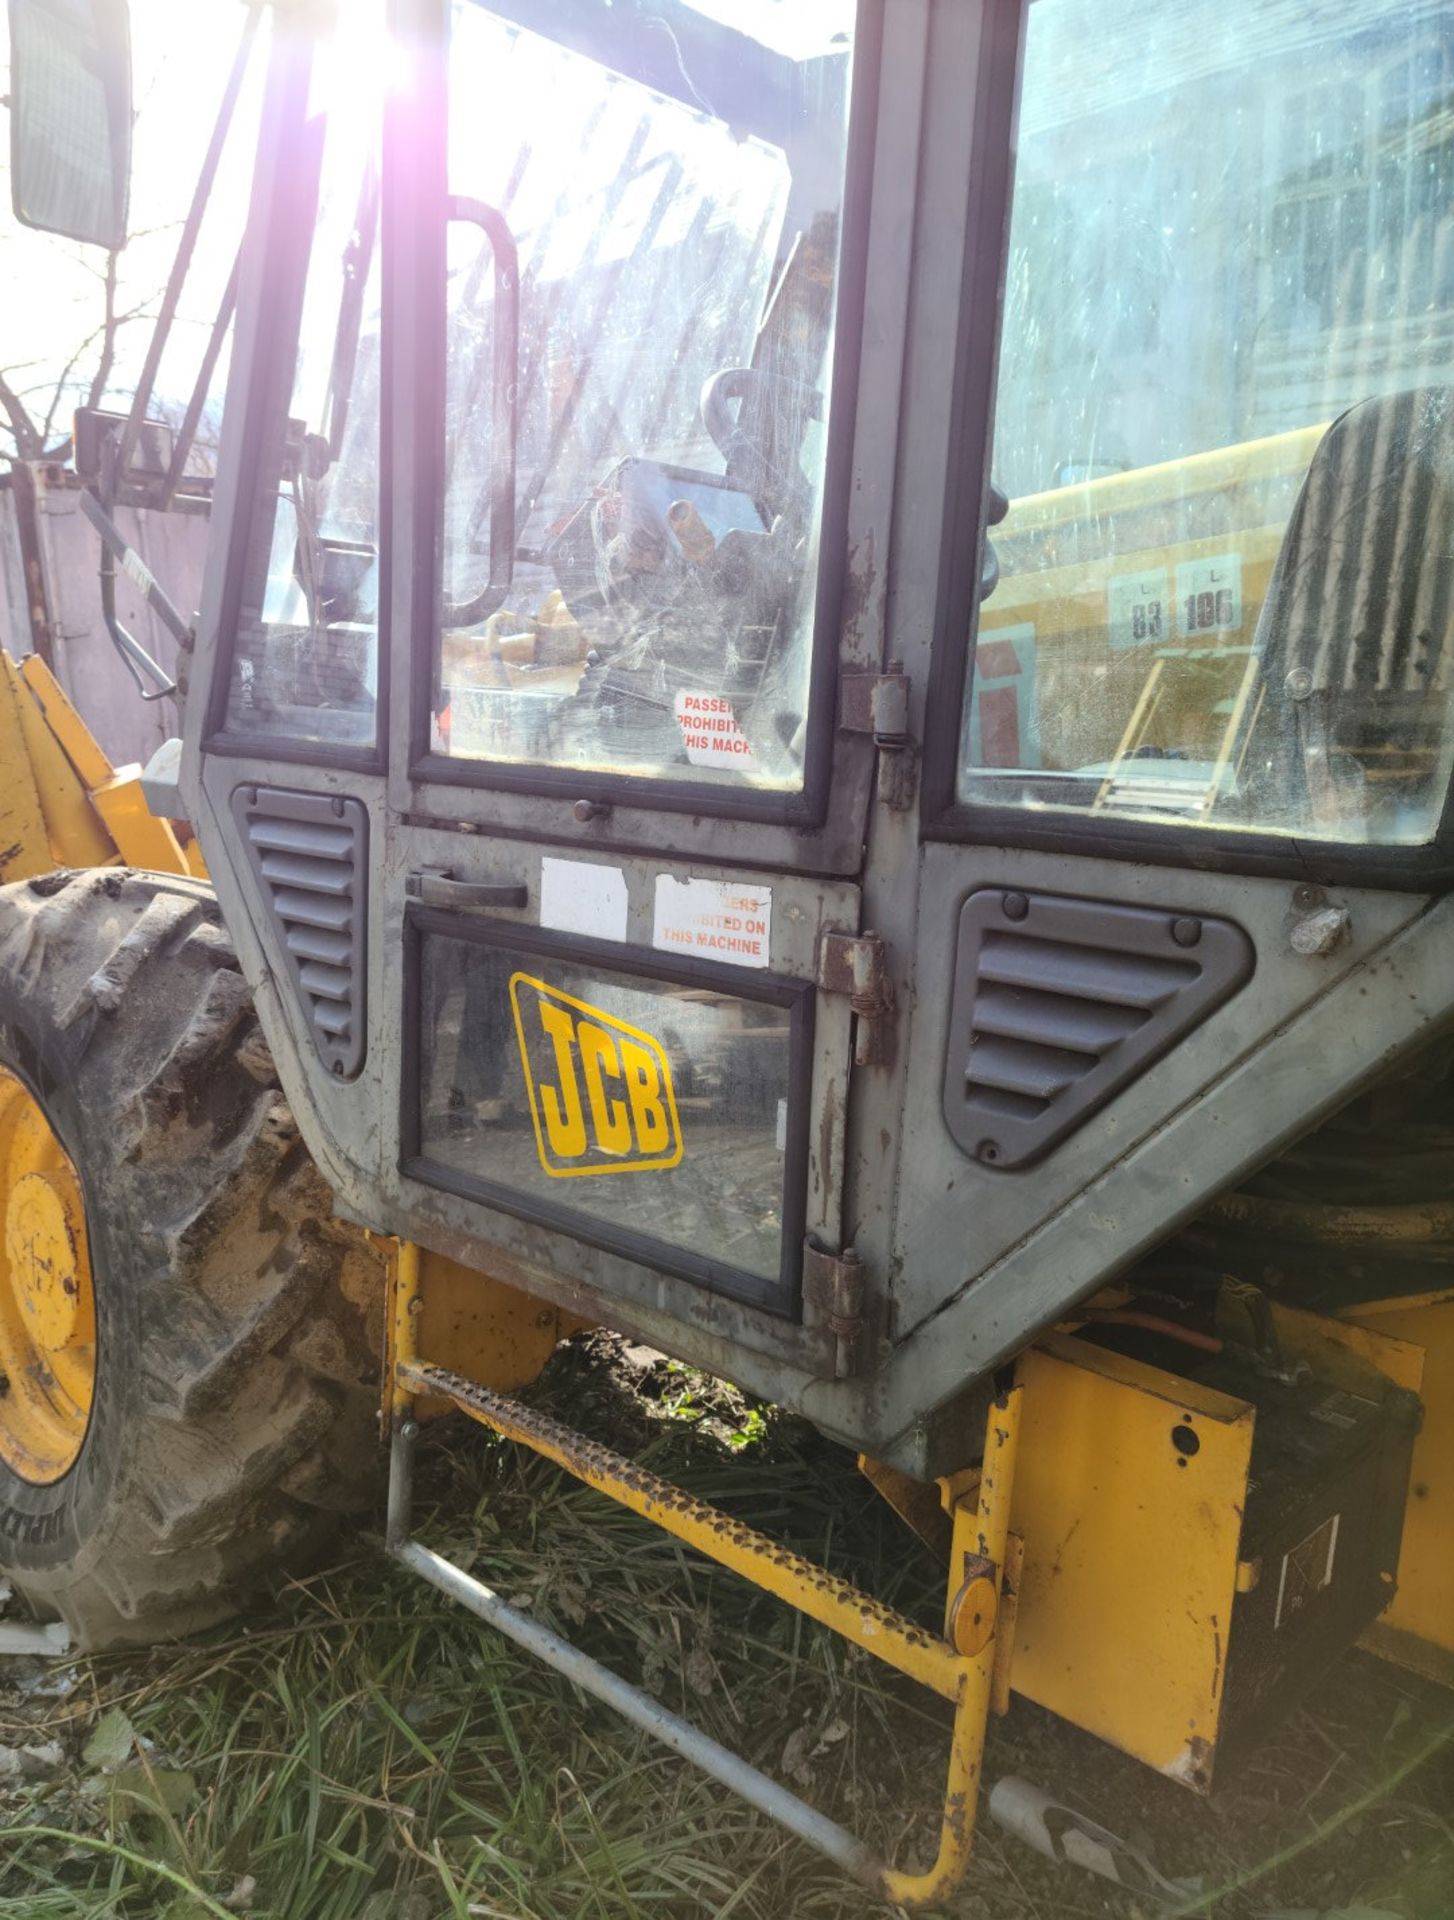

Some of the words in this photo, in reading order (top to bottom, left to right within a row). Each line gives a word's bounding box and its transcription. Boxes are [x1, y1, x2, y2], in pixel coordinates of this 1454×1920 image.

[1183, 587, 1233, 631] 106
[677, 714, 744, 735] PROHIBIT
[684, 734, 709, 750] HIS
[745, 919, 766, 935] ON
[663, 927, 693, 944] THIS
[697, 932, 761, 955] MACHINE
[539, 1000, 669, 1157] JCB
